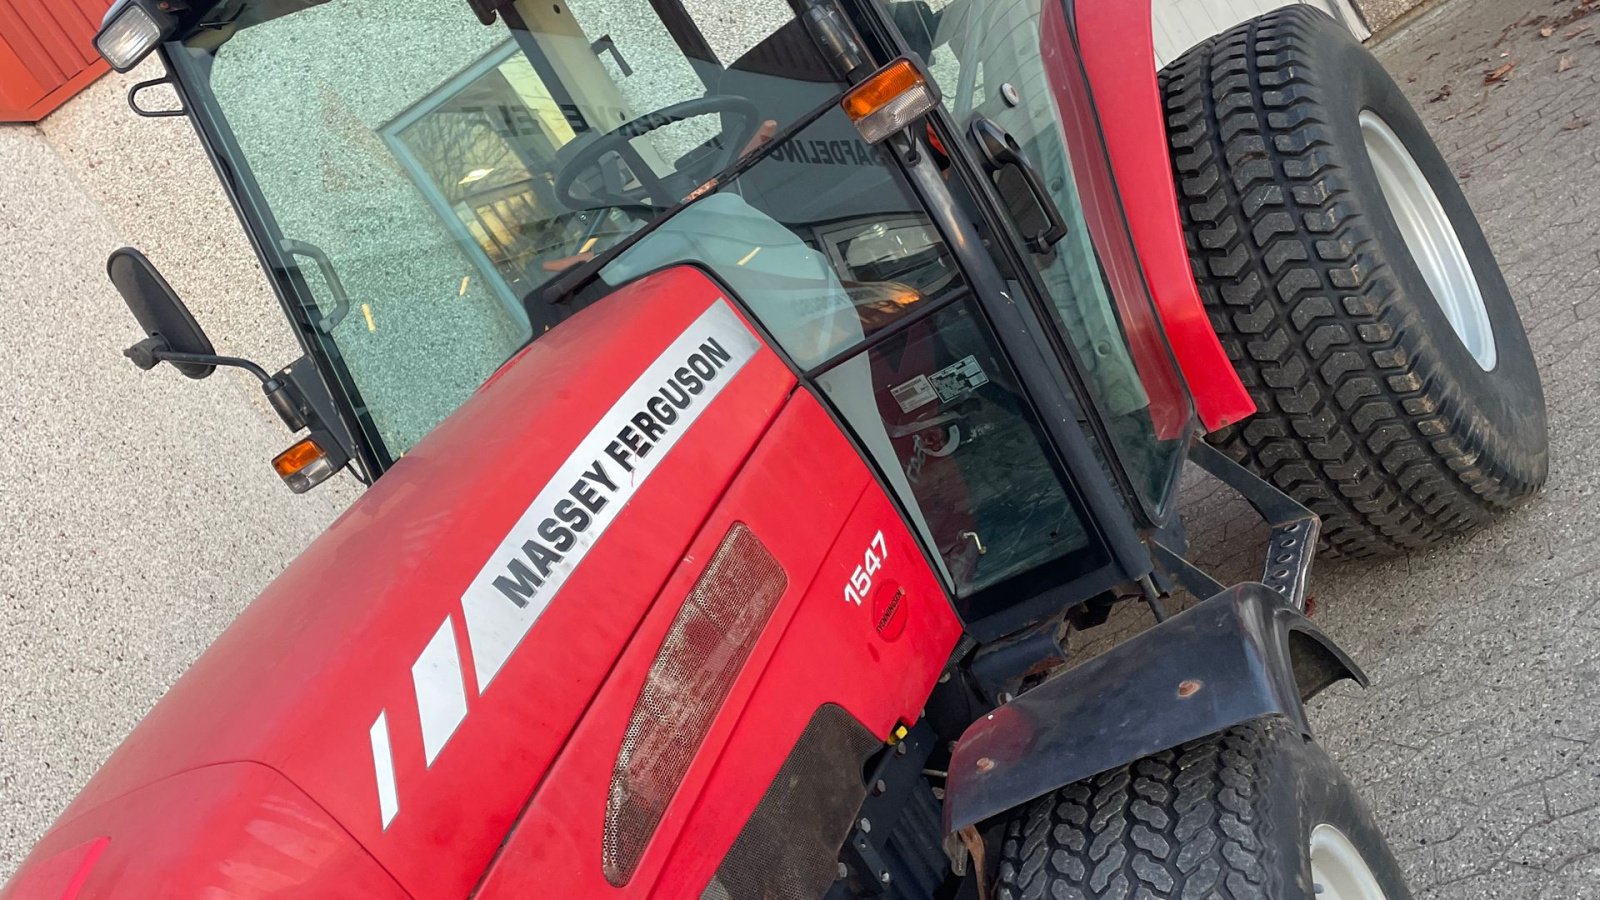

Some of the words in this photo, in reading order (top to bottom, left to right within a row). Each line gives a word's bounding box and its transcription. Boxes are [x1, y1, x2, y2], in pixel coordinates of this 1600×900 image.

[491, 459, 620, 609] MASSEY
[603, 336, 731, 473] FERGUSON
[844, 529, 888, 607] 1547
